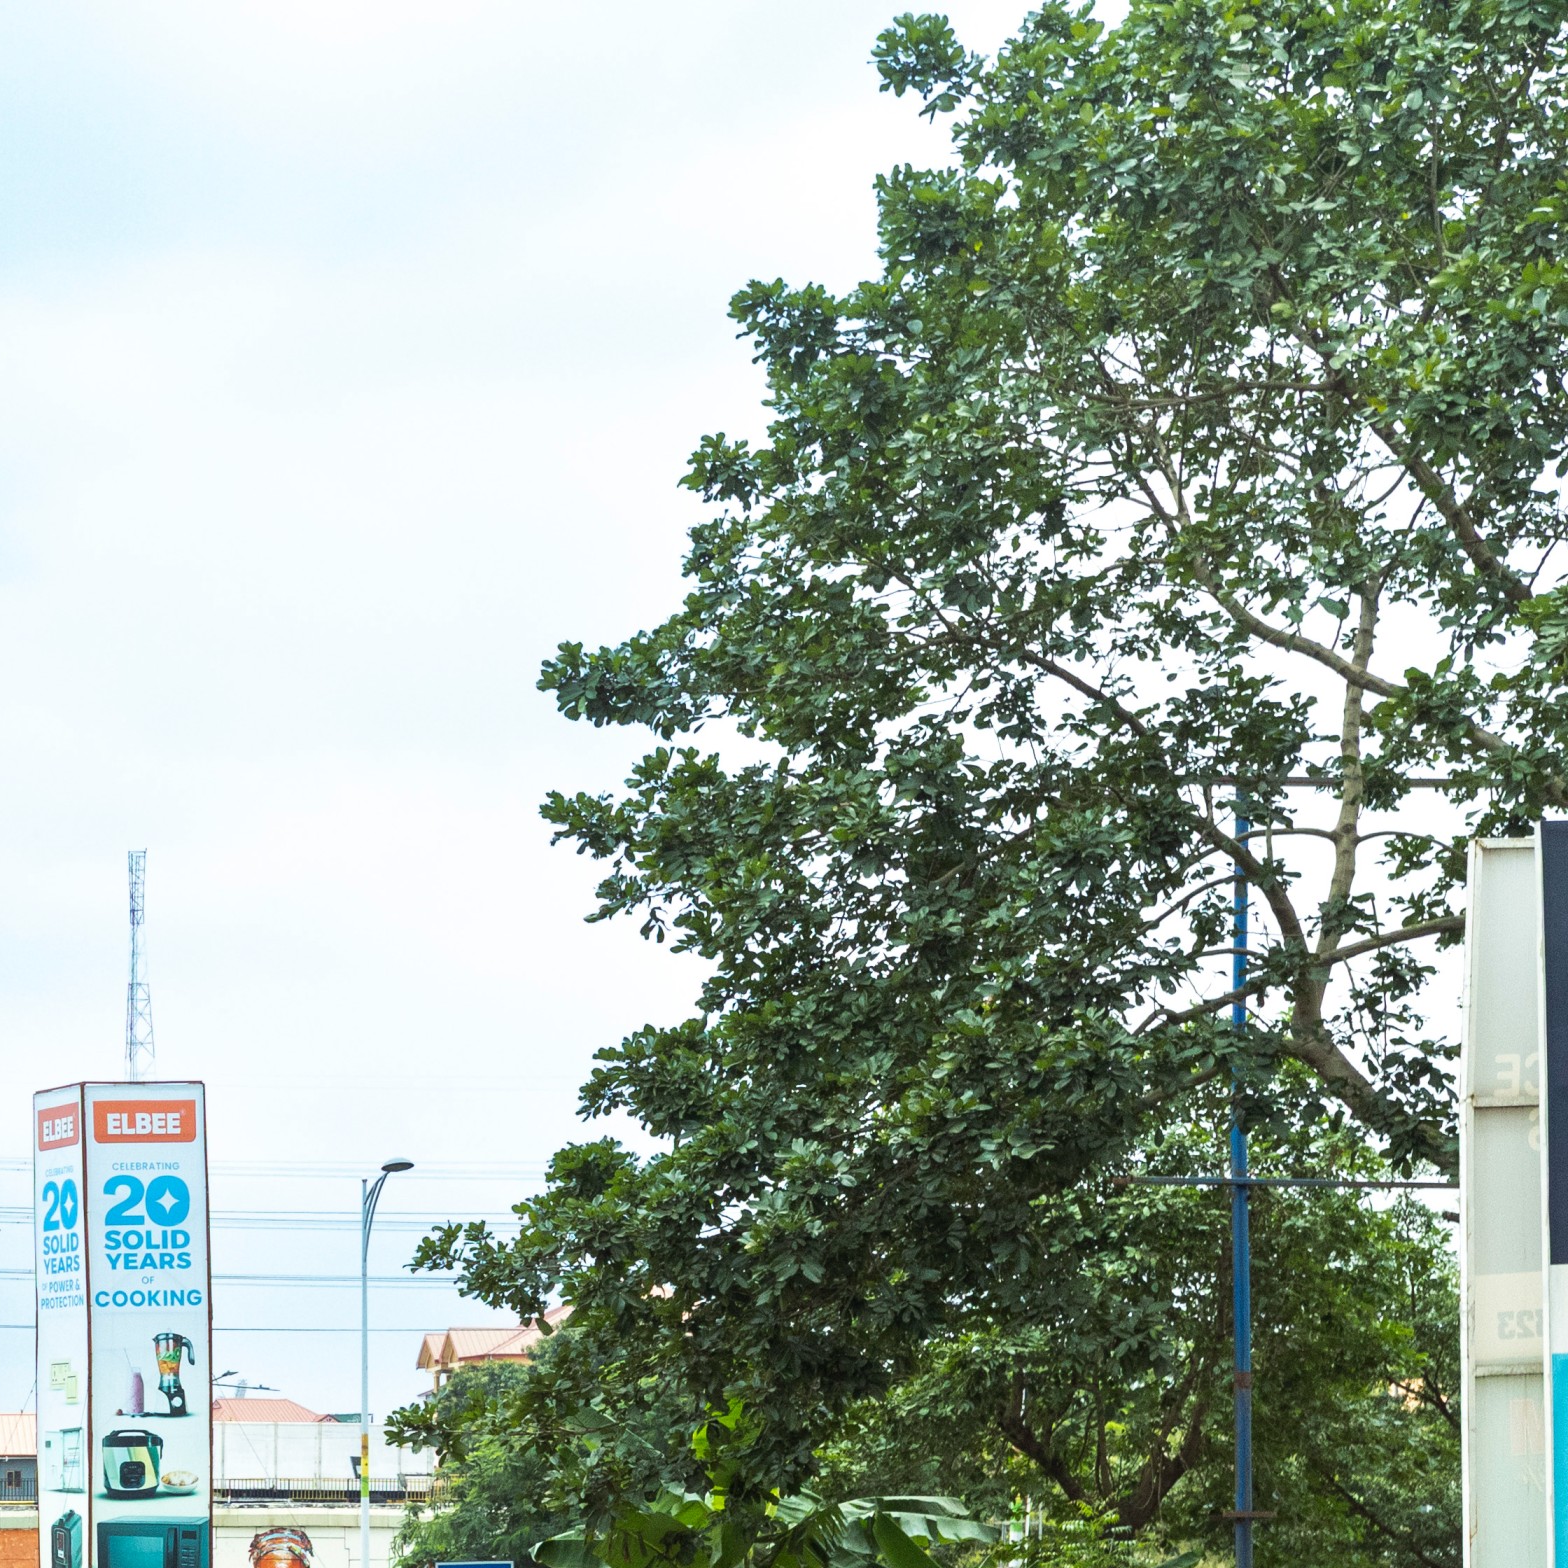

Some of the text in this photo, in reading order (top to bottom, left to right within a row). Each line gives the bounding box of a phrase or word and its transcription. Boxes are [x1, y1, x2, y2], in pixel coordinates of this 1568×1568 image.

[43, 1116, 74, 1142] ELBEE
[106, 1112, 181, 1135] ELBEE
[45, 1165, 74, 1177] CELEBRATING
[112, 1162, 180, 1171] CELEBRATING
[42, 1179, 78, 1232] 20
[103, 1175, 190, 1227] 20
[43, 1232, 79, 1256] SOLID
[104, 1230, 190, 1250] SOLID
[44, 1255, 80, 1275] YEARS
[105, 1252, 191, 1270] YEARS
[49, 1281, 72, 1293] POWER
[74, 1279, 80, 1290] &
[141, 1276, 154, 1285] OF
[41, 1295, 84, 1310] PROTECTION
[95, 1289, 202, 1307] COOKING
